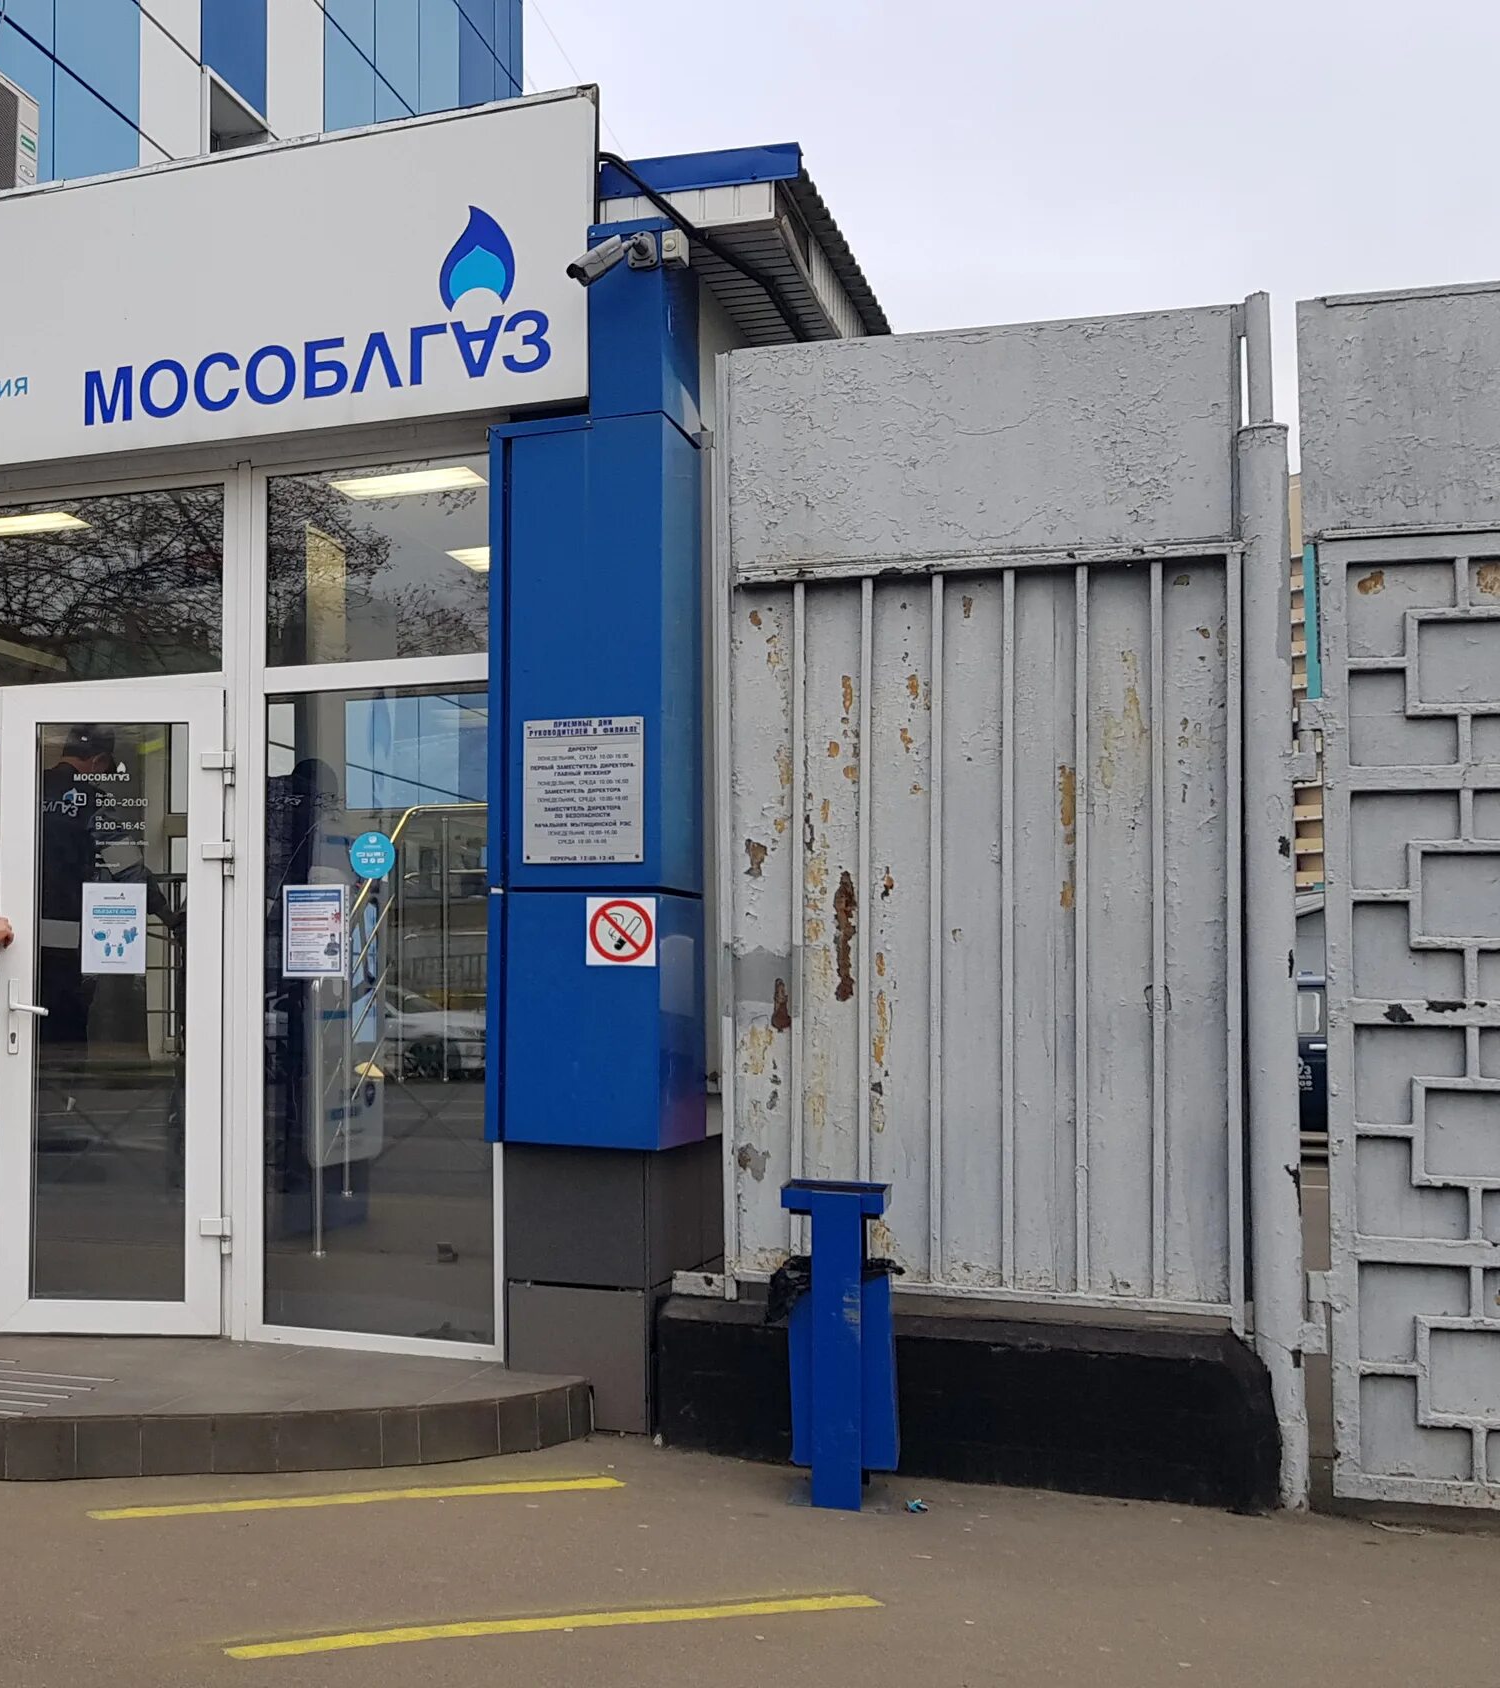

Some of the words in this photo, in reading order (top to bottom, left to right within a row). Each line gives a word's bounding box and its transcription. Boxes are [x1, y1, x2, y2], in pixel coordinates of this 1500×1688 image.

[84, 309, 551, 426] МОСОБЛГАЗ
[553, 719, 593, 728] ПРИЕМНЫЕ
[598, 719, 613, 727] ДНИ
[529, 728, 588, 737] РУКОВОДИТЕЛЕЙ
[603, 726, 638, 734] ФИЛИАЛЕ
[73, 773, 131, 782] МОСОБЛГАЗ
